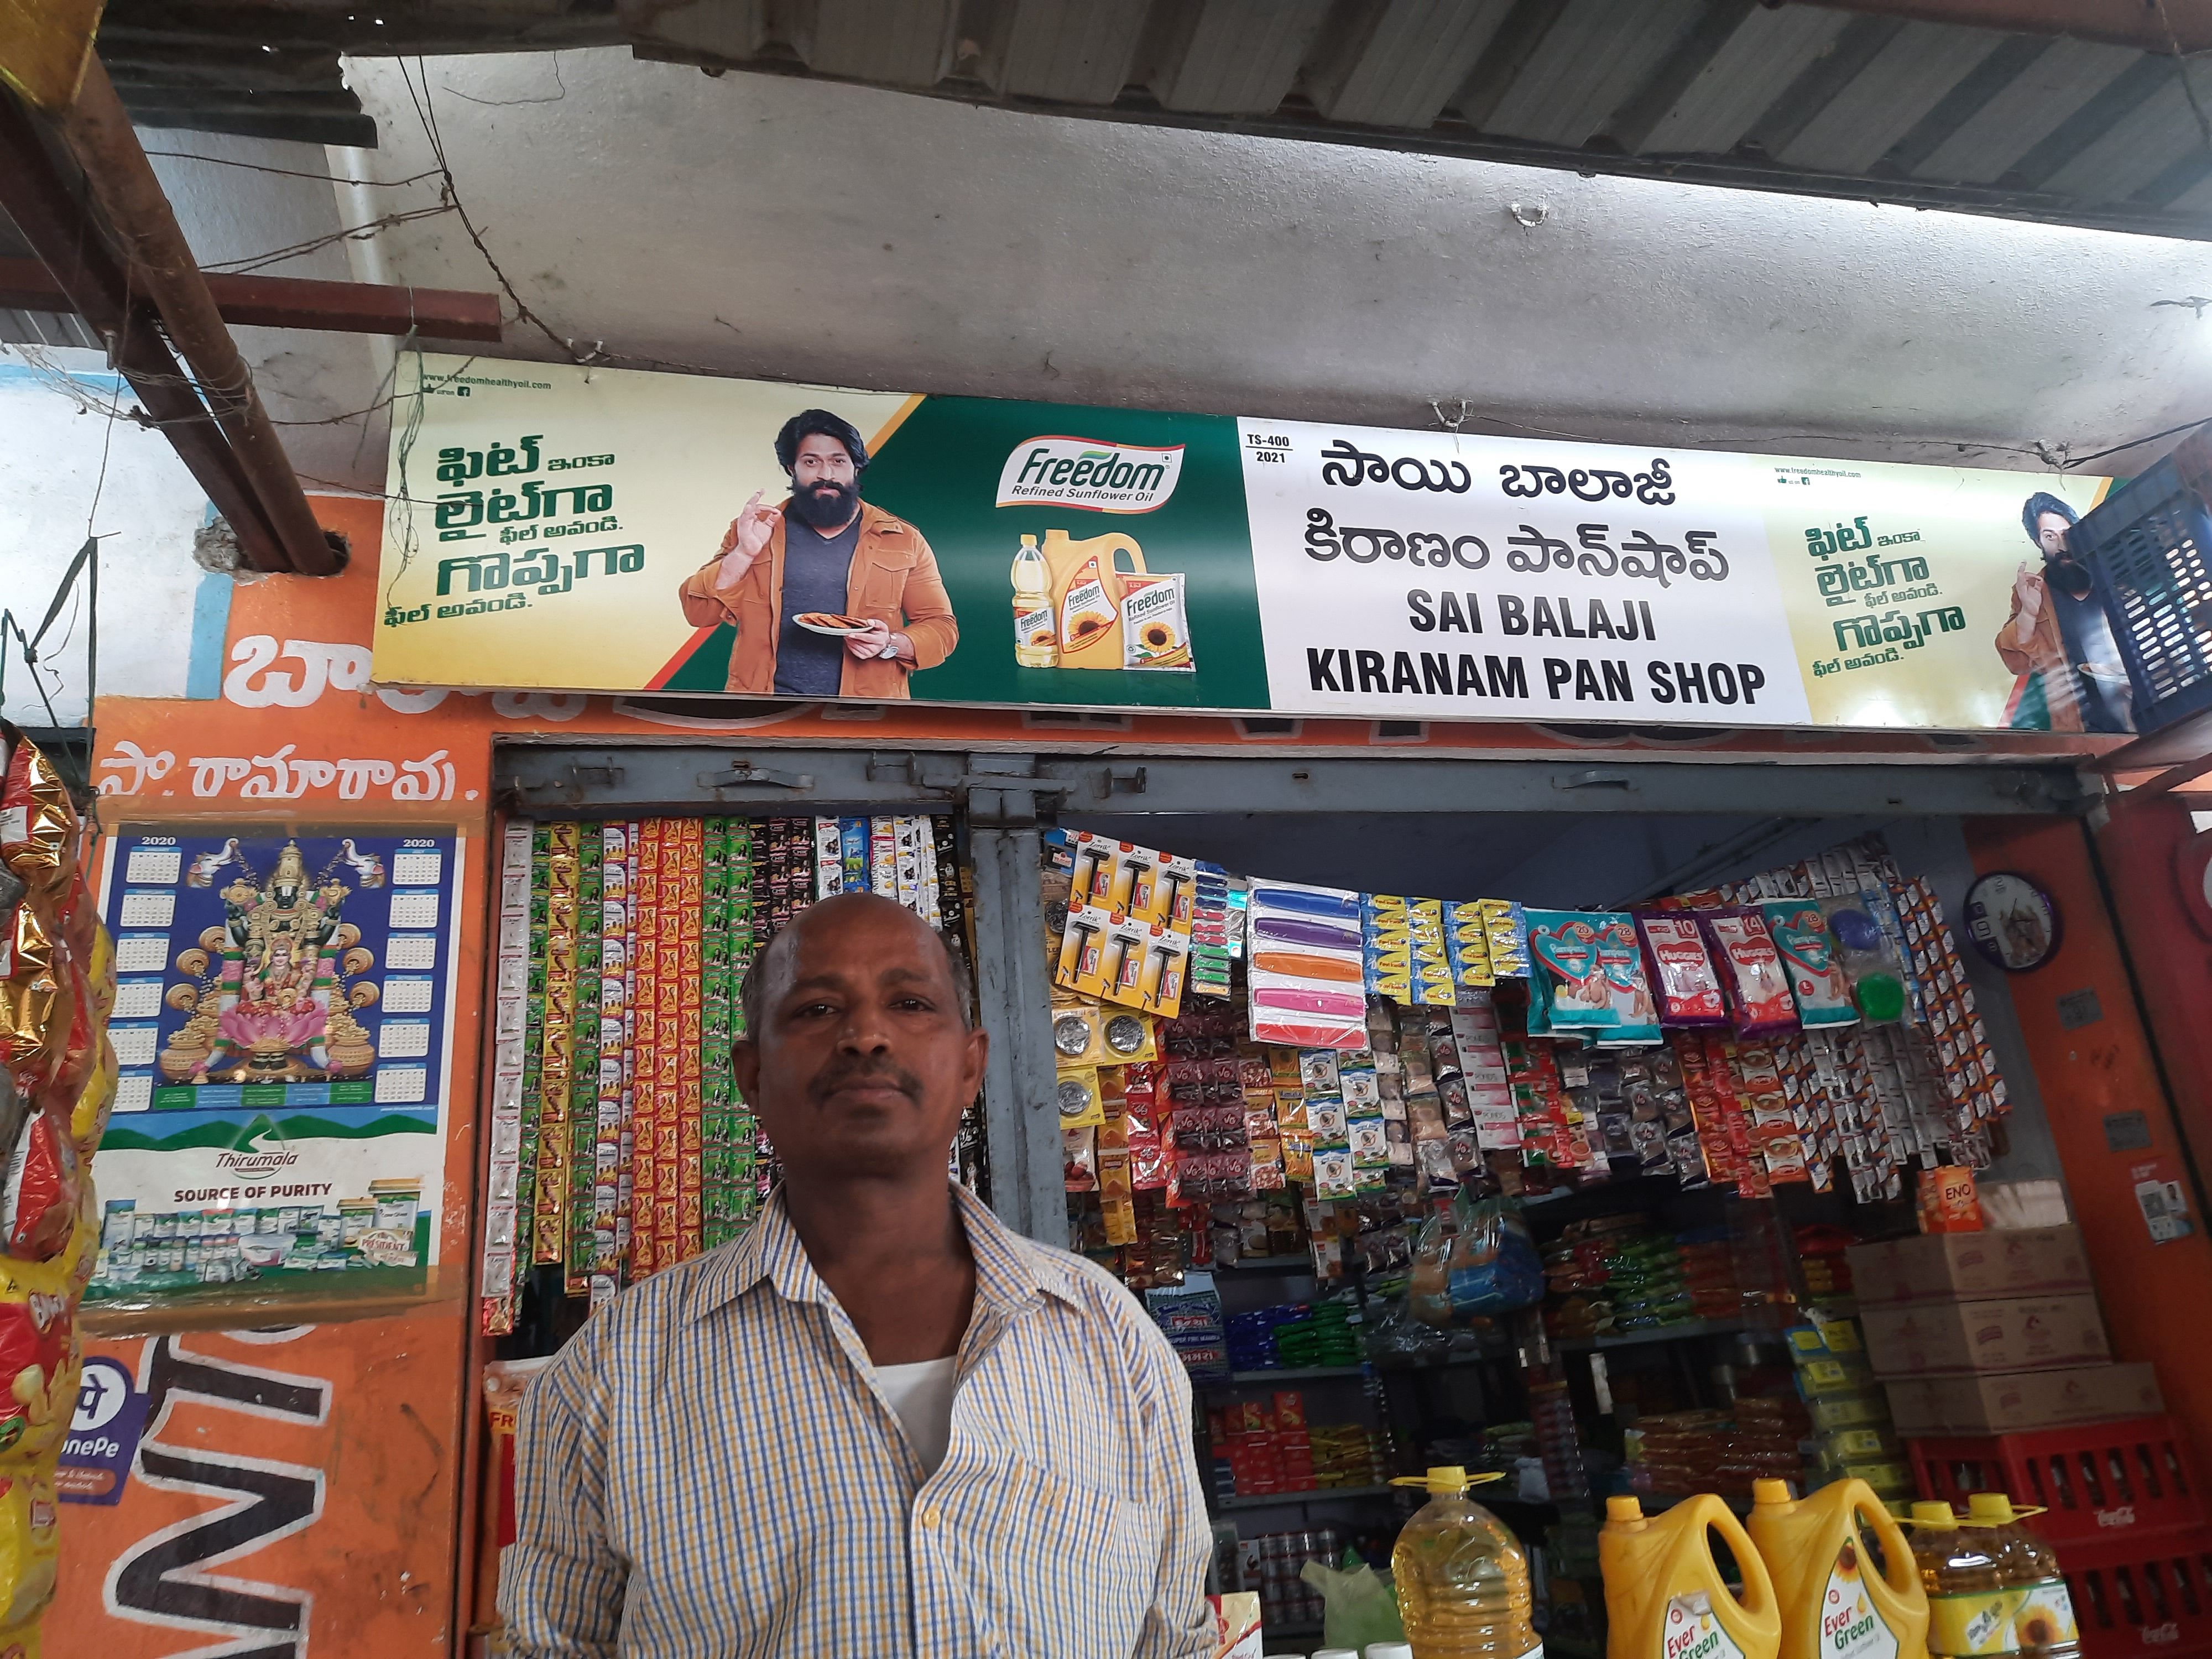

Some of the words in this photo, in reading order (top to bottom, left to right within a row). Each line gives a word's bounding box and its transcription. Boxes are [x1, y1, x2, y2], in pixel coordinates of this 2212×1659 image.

[1247, 434, 1290, 447] TS-400
[436, 434, 544, 487] ఫిట్
[547, 454, 615, 471] ఇంకా
[1256, 451, 1285, 463] 2021
[1016, 448, 1166, 491] Freedom
[1321, 439, 1472, 494] సాయి
[1500, 458, 1676, 507] బాలాజీ
[1011, 485, 1065, 498] Refined
[1066, 488, 1133, 502] Sunflower
[1135, 492, 1154, 502] Oil
[499, 524, 539, 545] ఫీల్
[1304, 507, 1490, 570] కిరాణం
[1804, 516, 1872, 561] ఫిట్
[1877, 531, 1921, 546] ఇంకా
[436, 544, 644, 596] గొప్పగా
[1068, 585, 1100, 607] Freedom
[1127, 587, 1175, 617] Freedom
[384, 603, 432, 628] ఫీల్
[1020, 610, 1048, 629] Freedom
[1407, 588, 1483, 635] SAI
[1497, 594, 1656, 641] BALAJI
[1833, 606, 1966, 651] గొప్పగా
[1306, 648, 1529, 698] KIRANAM
[1542, 657, 1634, 703] PAN
[1651, 662, 1766, 706] SHOP
[142, 836, 176, 846] 2020
[1576, 926, 1589, 934] 20
[1678, 920, 1697, 935] 10
[1744, 919, 1761, 933] 14
[1806, 915, 1819, 924] 28
[1619, 927, 1631, 936] 28
[216, 1151, 299, 1168] Thirumala
[174, 1186, 239, 1203] SOURCE
[246, 1186, 266, 1199] OF
[270, 1182, 333, 1198] PURITY
[1945, 1184, 1971, 1200] ENO
[1825, 1606, 1853, 1637] Ever
[1835, 1614, 1875, 1650] Green
[1667, 1624, 1695, 1659] Ever
[1679, 1631, 1719, 1659] Green
